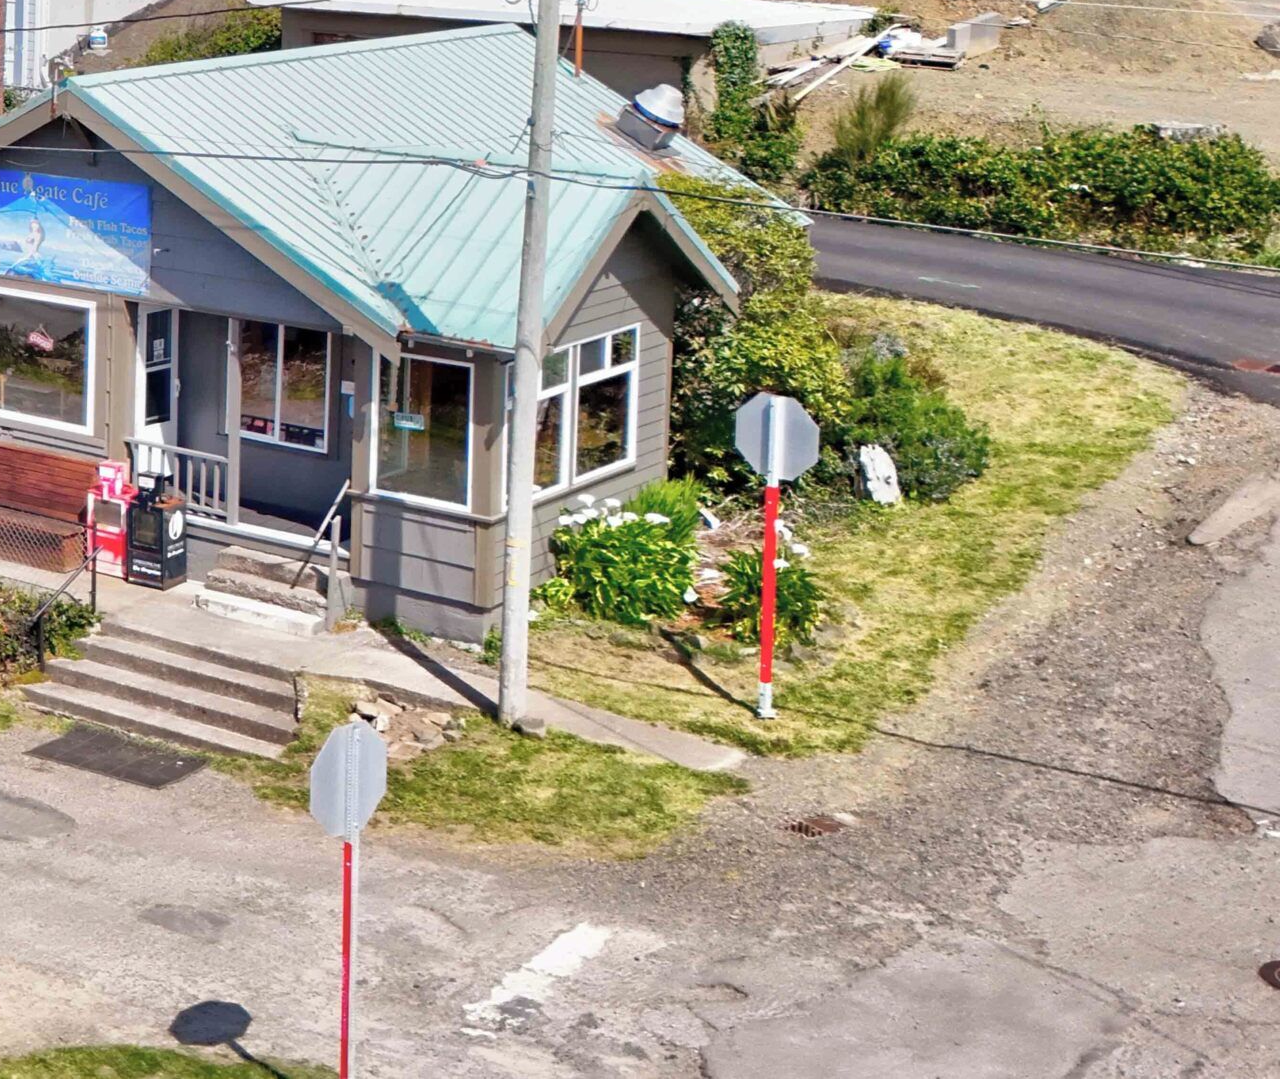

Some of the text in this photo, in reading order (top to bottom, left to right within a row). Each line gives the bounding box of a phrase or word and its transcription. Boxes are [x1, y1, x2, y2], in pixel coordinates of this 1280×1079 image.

[24, 177, 67, 201] gate
[72, 187, 109, 212] Café
[97, 220, 118, 232] Fish
[120, 222, 148, 235] Tacos
